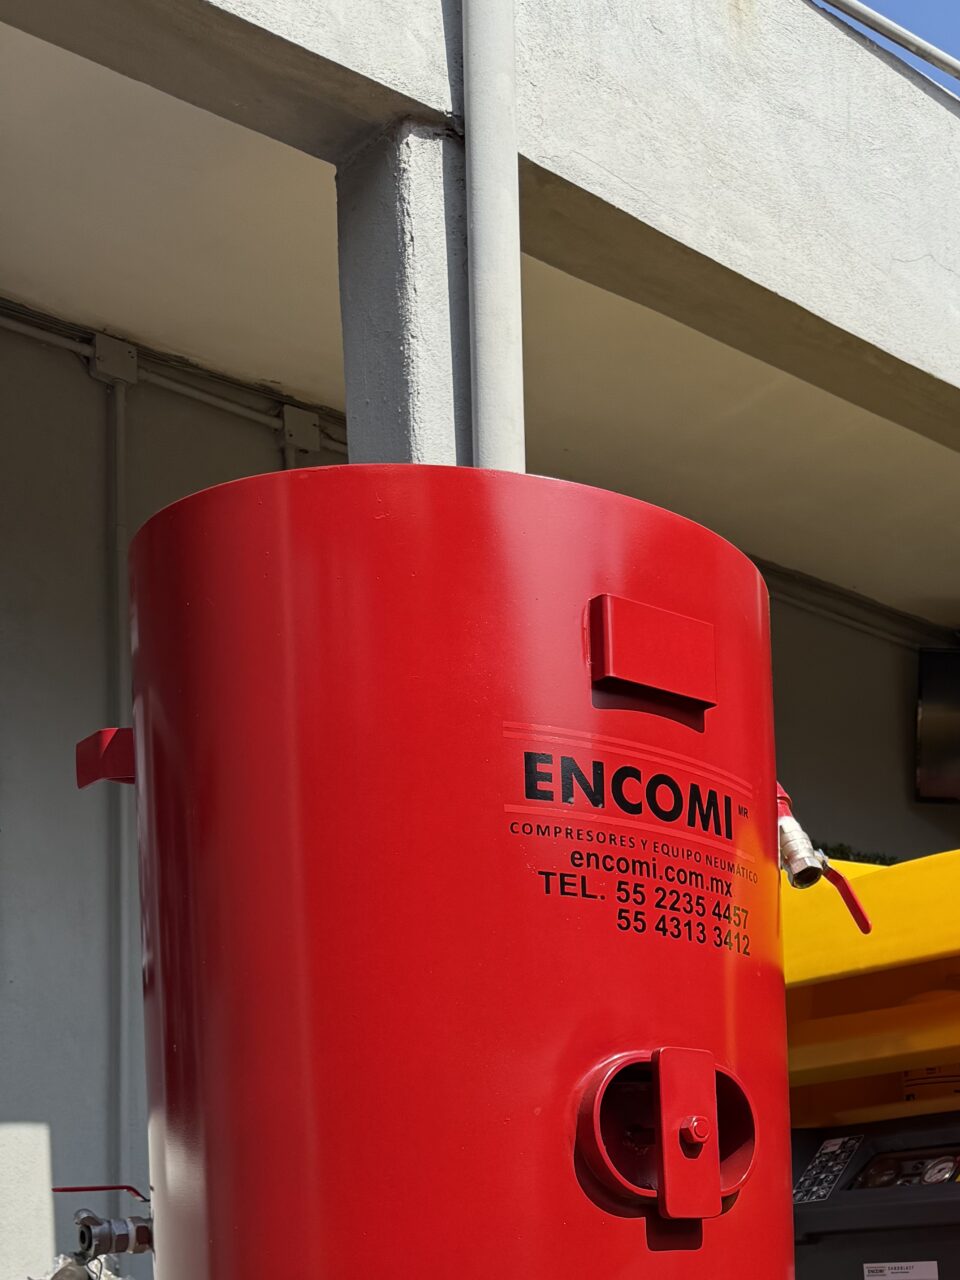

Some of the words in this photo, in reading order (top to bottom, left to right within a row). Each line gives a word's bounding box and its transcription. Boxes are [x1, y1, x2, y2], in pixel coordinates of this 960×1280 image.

[524, 751, 733, 840] ENCOMI
[510, 821, 635, 849] COMPRESORES
[641, 839, 648, 851] Y
[653, 841, 702, 863] EQUIPO
[705, 854, 758, 885] NEUMÁTICO
[570, 850, 732, 898] encomi.com.mx
[538, 870, 605, 901] TEL.
[616, 880, 646, 906] 55
[654, 886, 706, 917] 2235
[711, 901, 749, 930] 4457
[616, 908, 647, 933] 55
[654, 914, 706, 944] 4313
[713, 922, 750, 956] 3412
